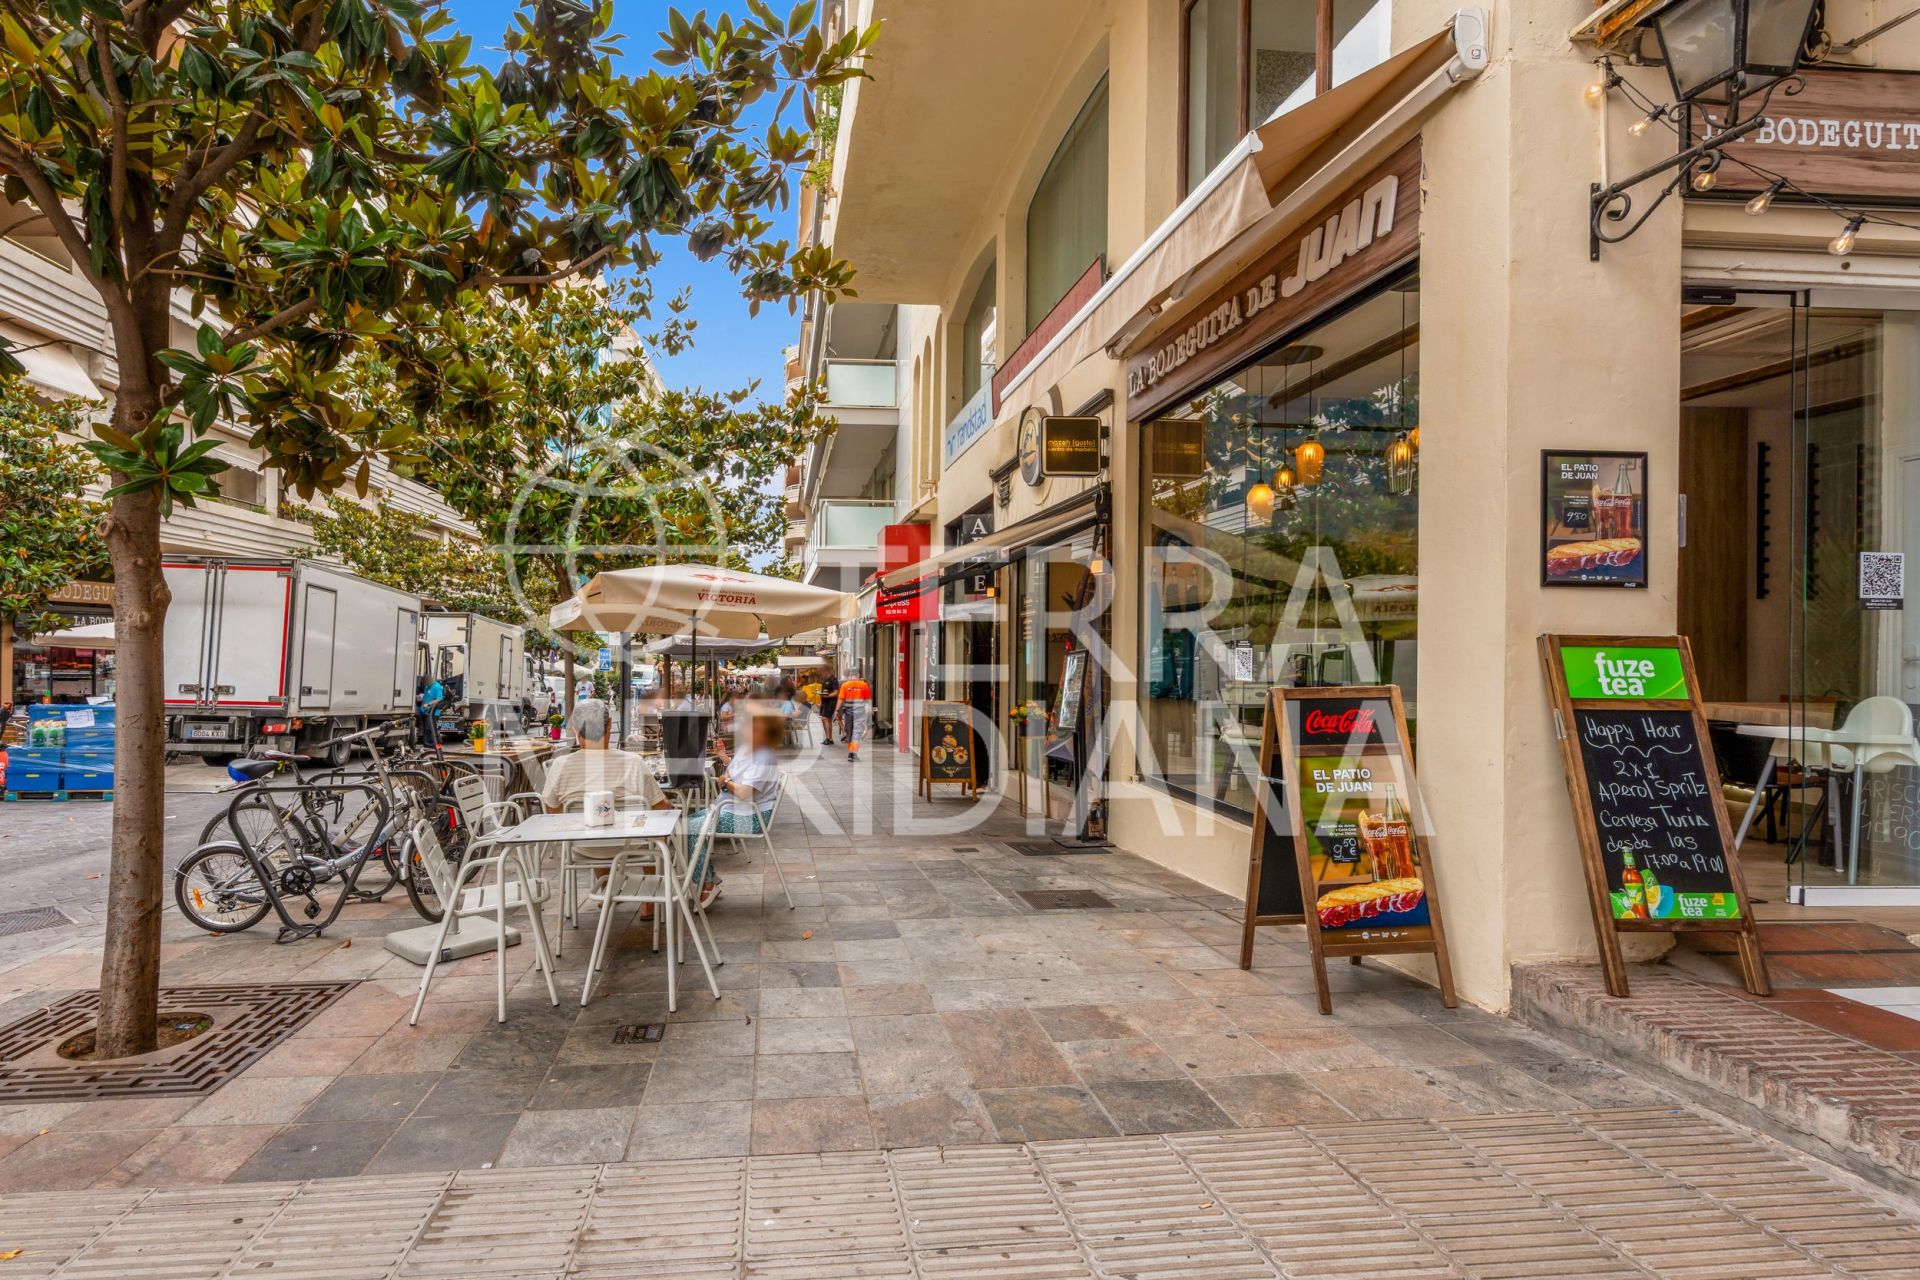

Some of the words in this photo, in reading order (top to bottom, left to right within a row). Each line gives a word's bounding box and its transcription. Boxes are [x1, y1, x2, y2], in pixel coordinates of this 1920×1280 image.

[1755, 117, 1920, 149] BODEGUIT
[1128, 372, 1146, 398] LA
[1148, 296, 1243, 385] BODEGUITA
[1245, 274, 1276, 317] DE
[697, 592, 756, 605] VICTORIA
[73, 615, 86, 627] LA
[1594, 652, 1655, 677] fuze
[1598, 676, 1646, 696] tea
[1305, 709, 1376, 734] Coca-Cola
[1585, 716, 1634, 744] Happy
[1642, 717, 1681, 738] Hour
[1313, 769, 1331, 780] EL
[1332, 768, 1371, 780] PATIO
[1316, 782, 1335, 793] DE
[1337, 781, 1373, 793] JUAN
[1599, 779, 1654, 806] Aperol
[1600, 810, 1658, 832] Cerveza
[1606, 833, 1652, 852] desde
[1667, 832, 1698, 850] las
[1644, 853, 1678, 870] 17:00
[1680, 859, 1691, 871] a
[1692, 853, 1724, 874] 19:00
[1678, 893, 1708, 907] fuze
[1681, 905, 1704, 916] tea
